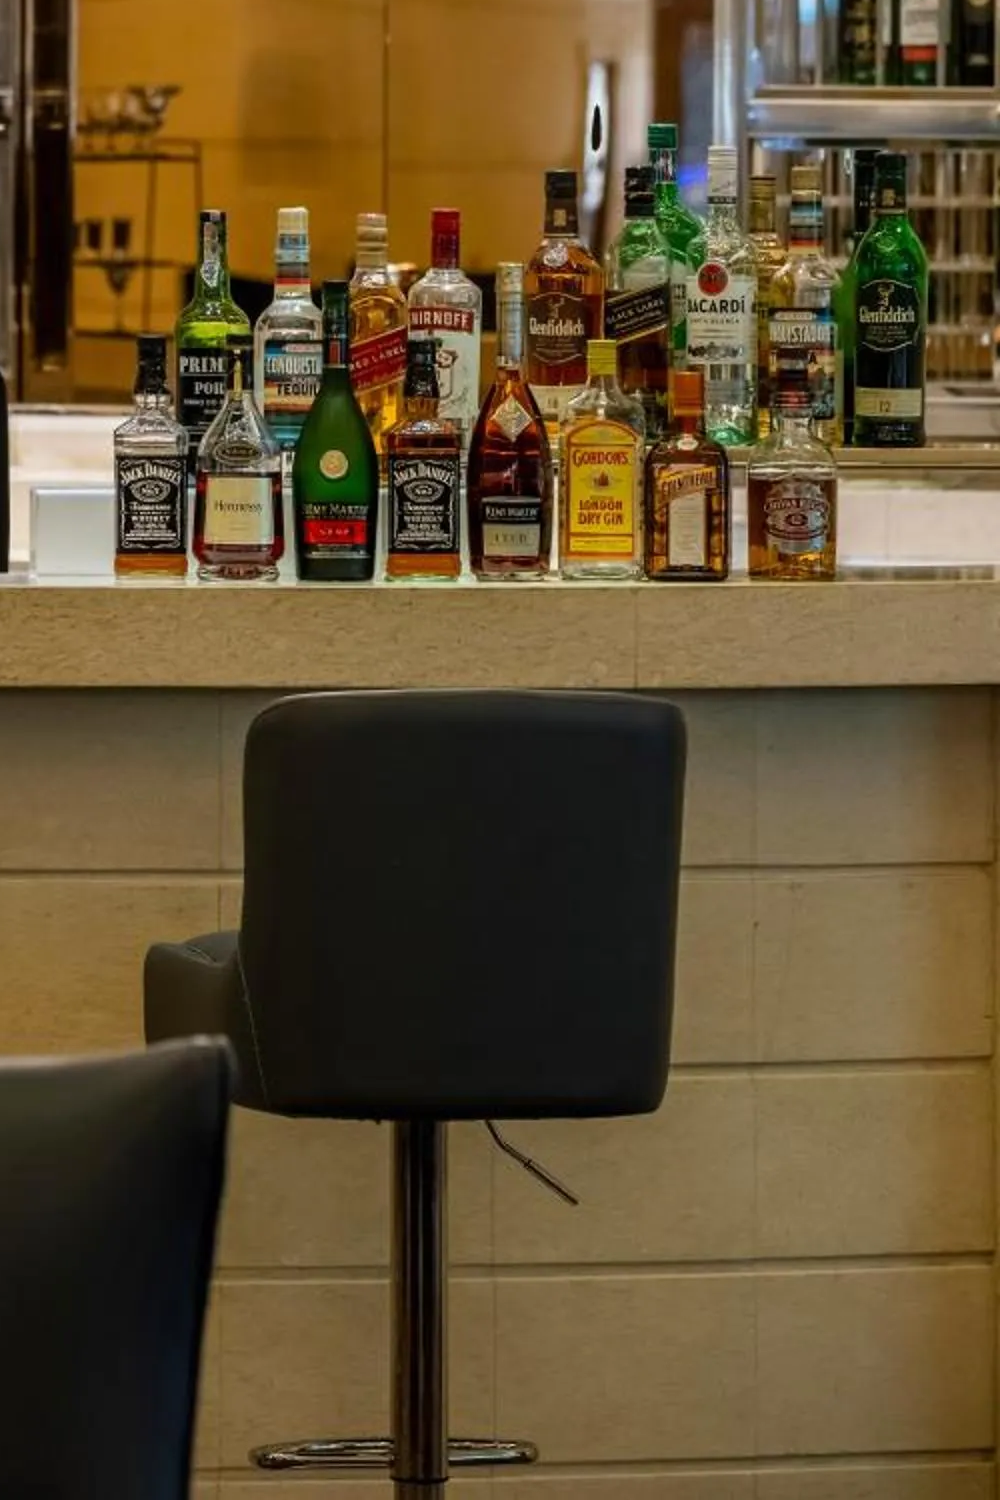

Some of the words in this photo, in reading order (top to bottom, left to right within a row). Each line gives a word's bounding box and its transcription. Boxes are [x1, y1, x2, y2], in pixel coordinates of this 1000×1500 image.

[860, 305, 915, 323] Glenfiddich
[529, 317, 585, 337] Glenfiddich
[180, 355, 226, 373] PRIM
[579, 499, 623, 511] LONDON
[578, 512, 601, 525] DRY
[603, 512, 623, 525] GIN
